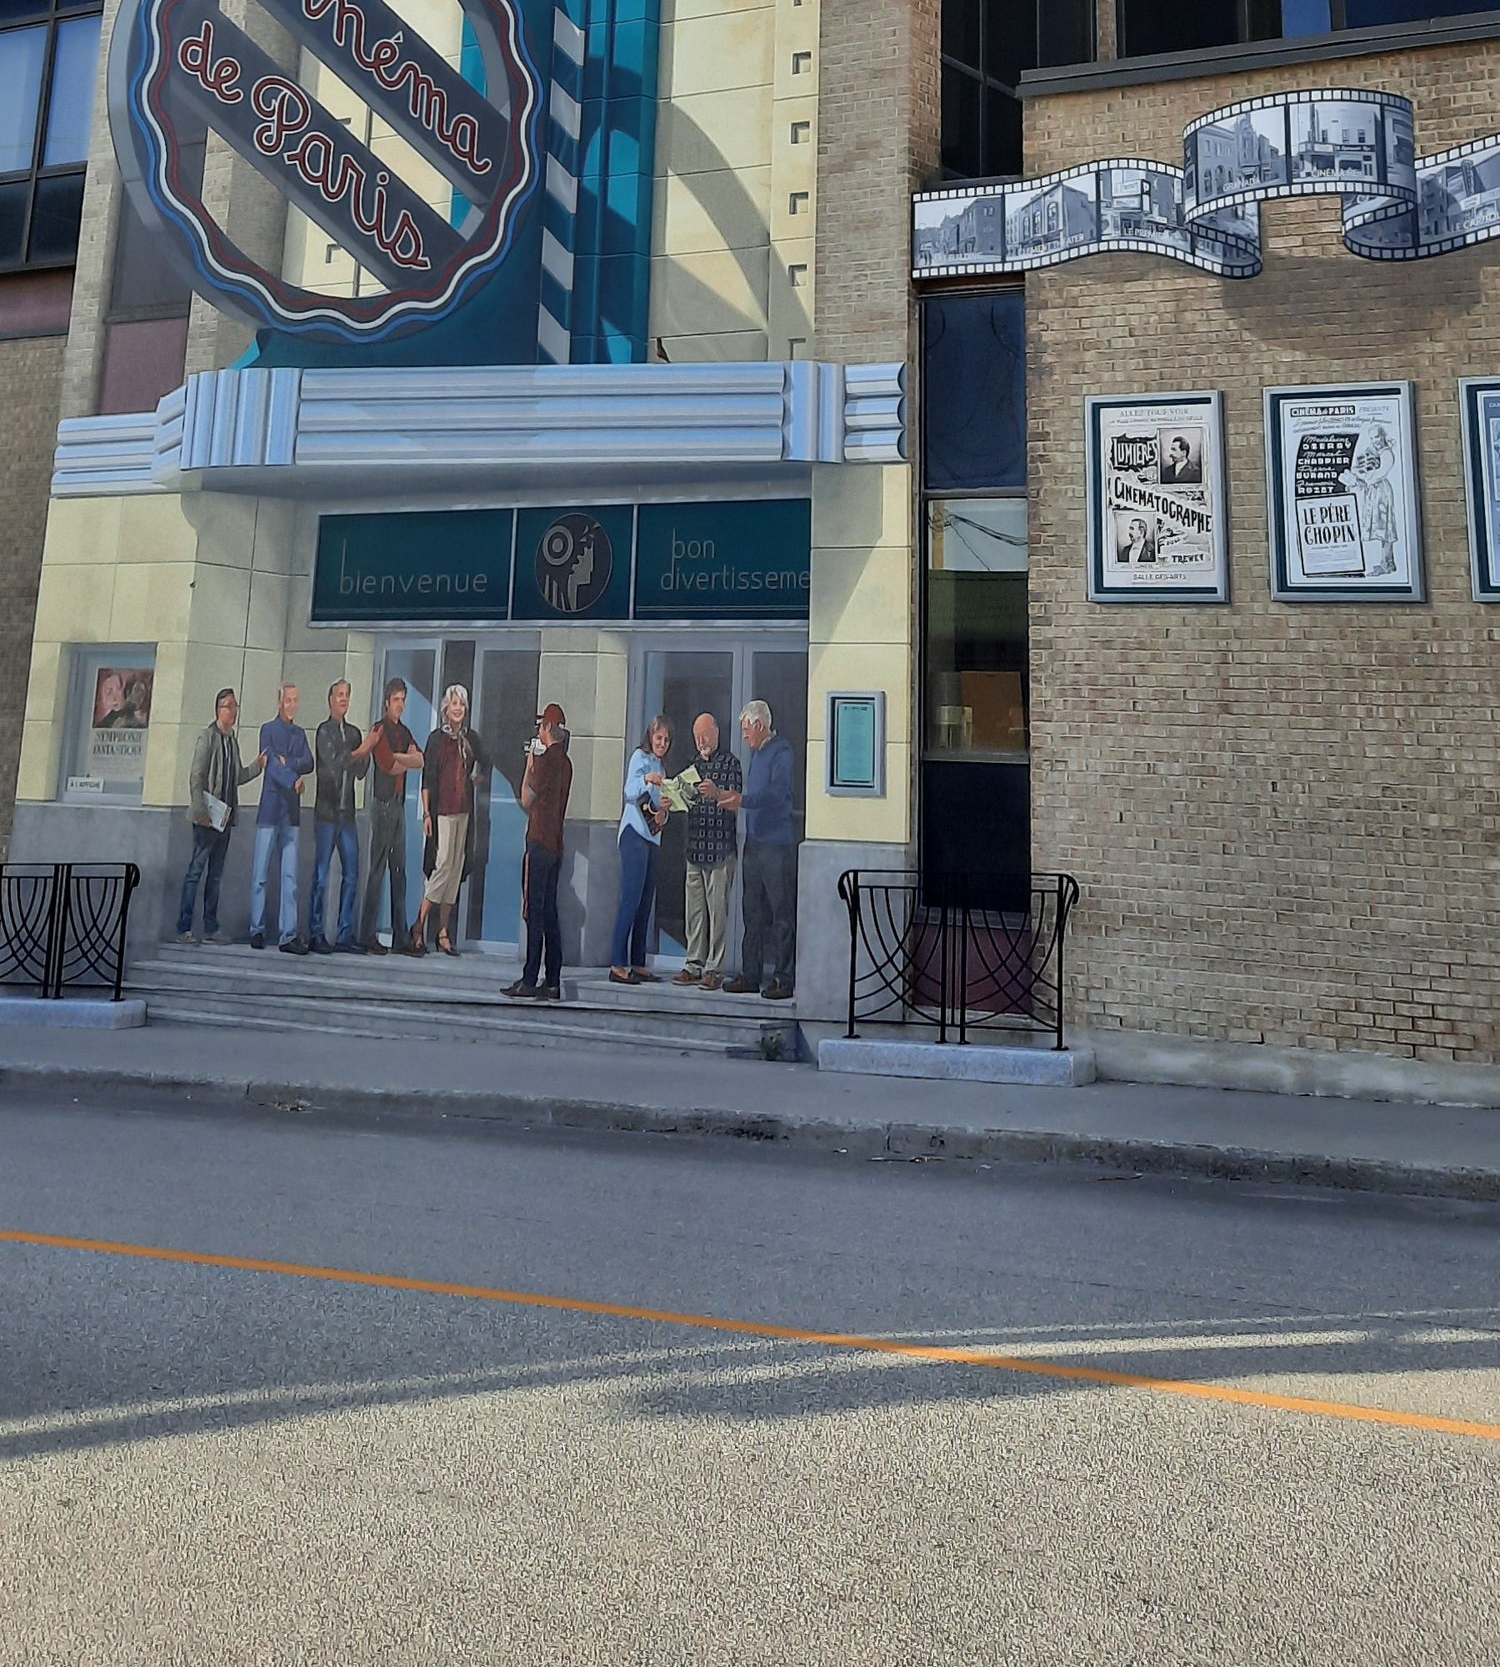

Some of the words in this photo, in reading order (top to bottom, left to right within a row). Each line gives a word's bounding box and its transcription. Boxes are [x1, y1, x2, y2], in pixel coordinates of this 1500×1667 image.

[178, 20, 244, 103] de
[252, 74, 433, 270] Paris
[1303, 507, 1318, 526] LE
[672, 527, 715, 559] bon
[1304, 524, 1356, 545] CHOPIN
[339, 537, 488, 595] bienvenue
